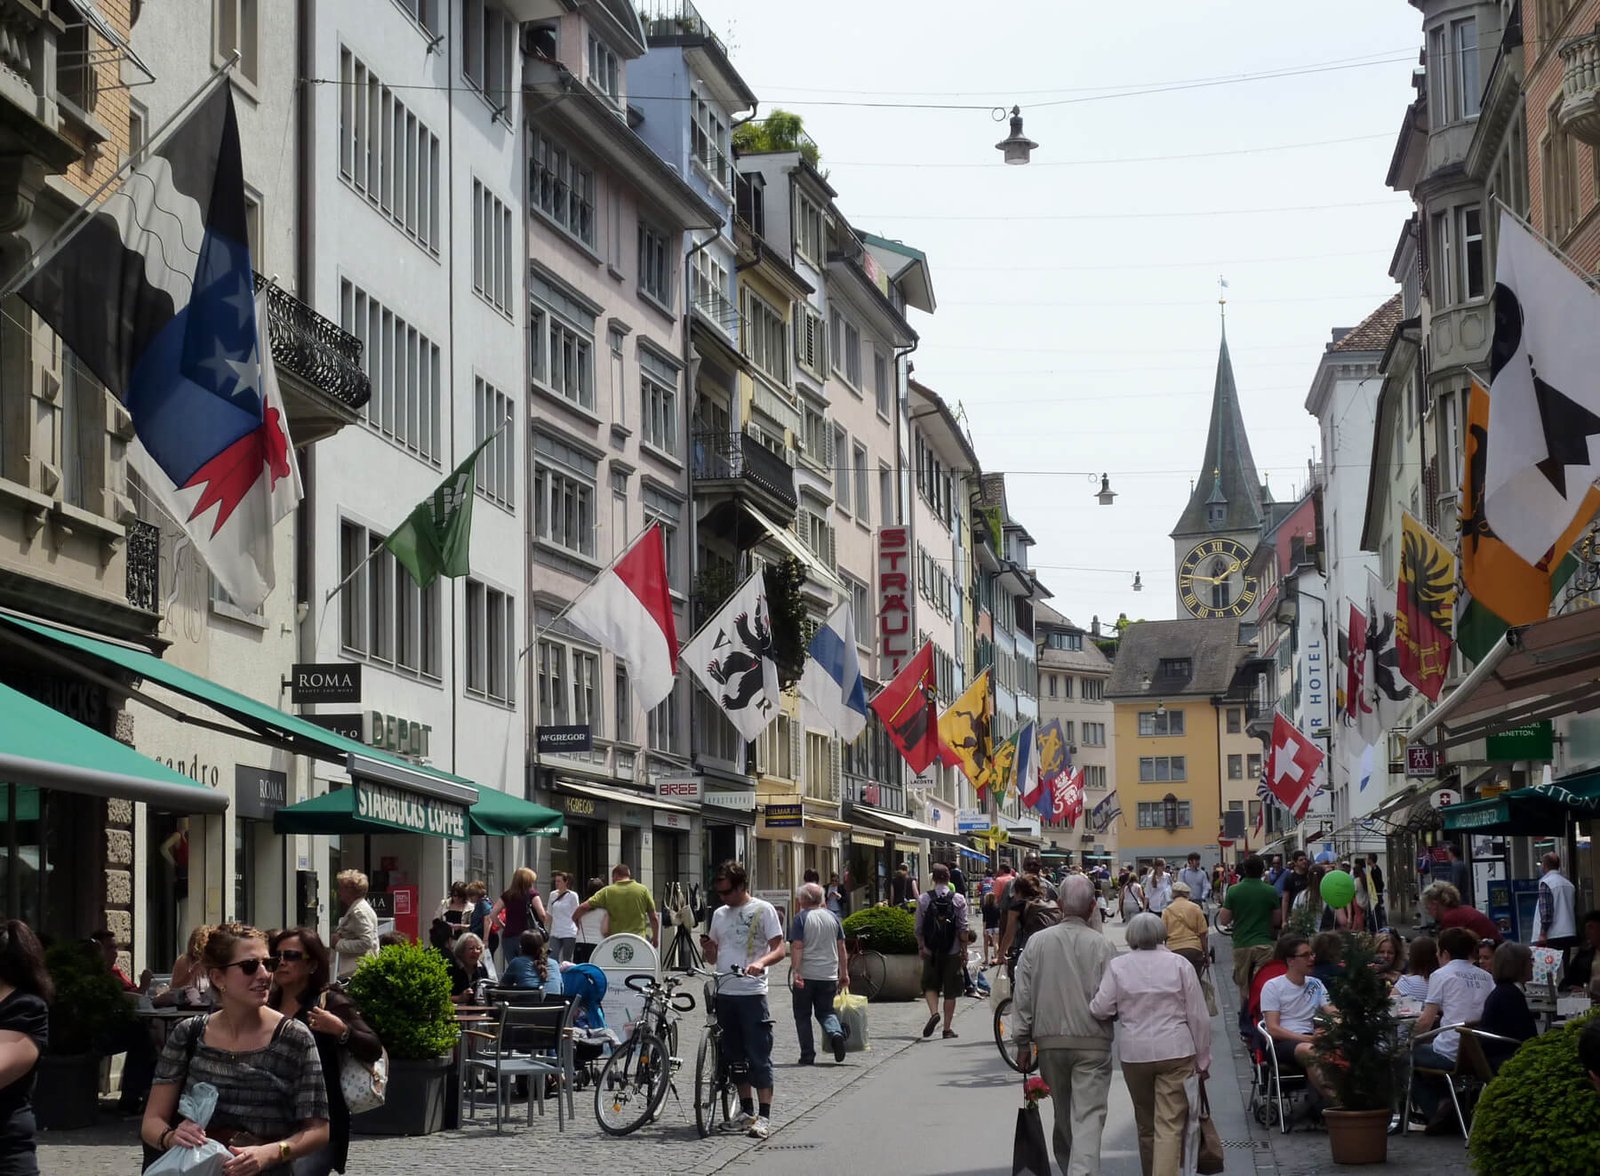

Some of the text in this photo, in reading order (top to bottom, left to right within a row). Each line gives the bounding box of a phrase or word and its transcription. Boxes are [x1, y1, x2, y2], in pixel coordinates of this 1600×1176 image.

[299, 673, 352, 688] ROMA
[1308, 640, 1321, 704] HOTEL
[372, 710, 433, 757] DEPOT
[259, 779, 284, 801] ROMA
[659, 783, 698, 796] BREE
[1529, 784, 1599, 810] ETTON
[358, 780, 465, 838] STARBUCKS COFFEE
